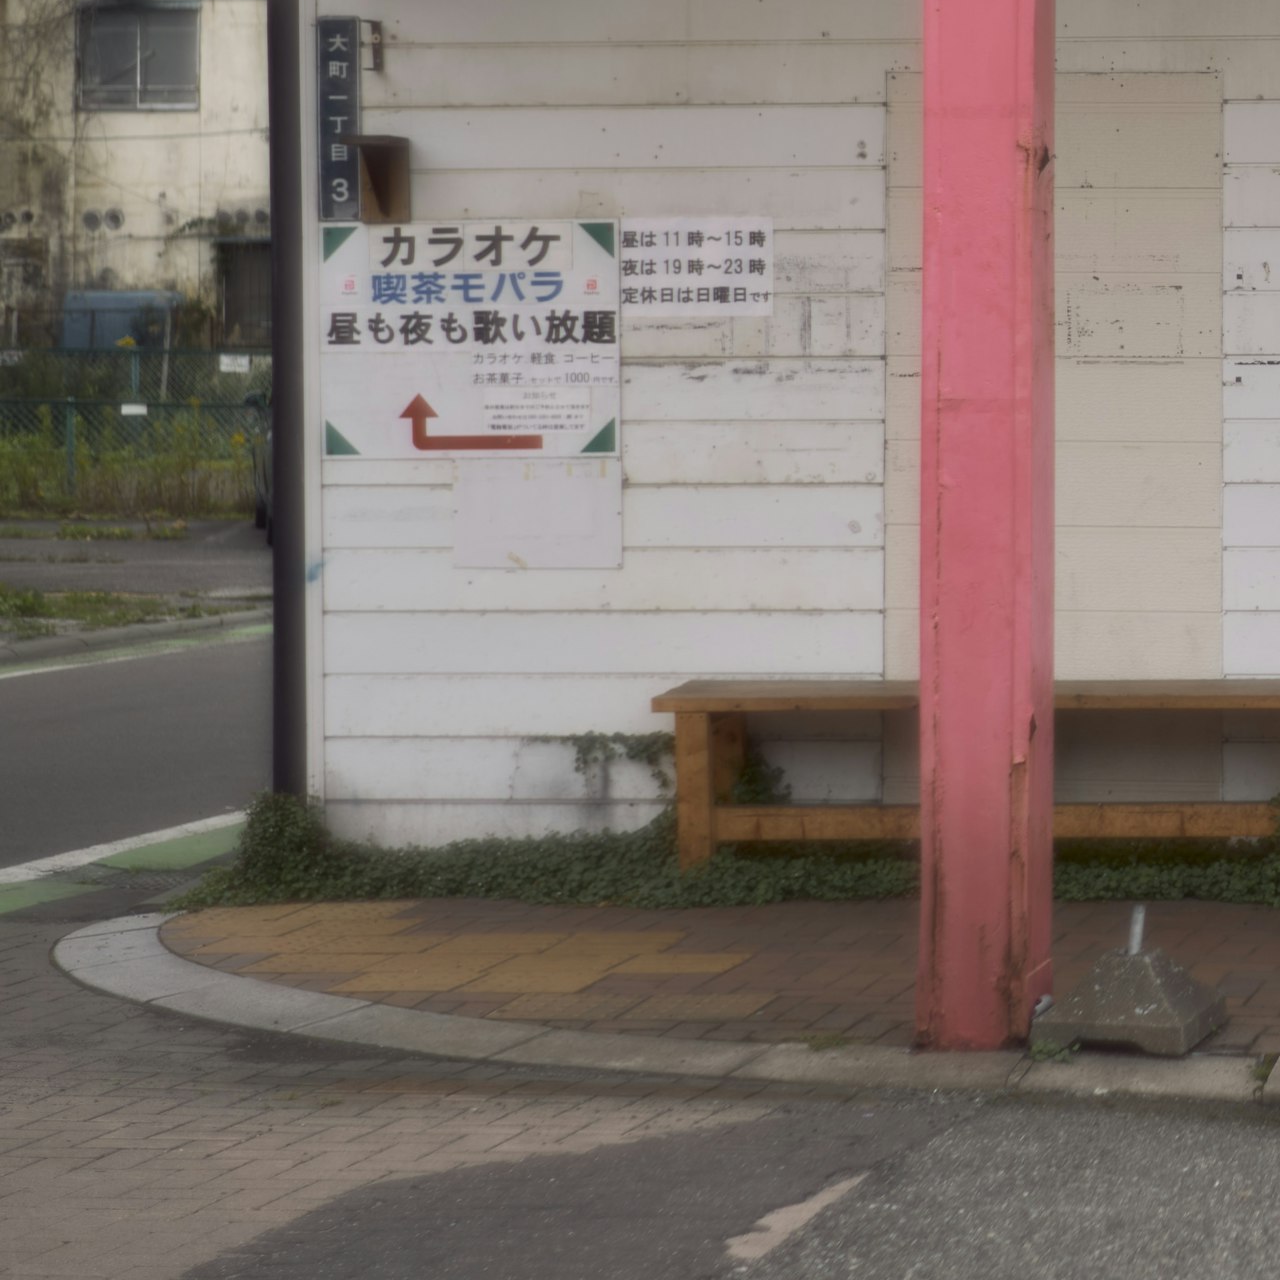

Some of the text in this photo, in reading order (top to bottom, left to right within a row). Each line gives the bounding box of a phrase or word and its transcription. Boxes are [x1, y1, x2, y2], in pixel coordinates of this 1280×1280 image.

[380, 226, 561, 267] カラオケ
[371, 272, 564, 305] 喫茶モパラ
[622, 286, 772, 304] 定休日は日曜日です
[327, 310, 616, 345] 昼も夜も歌い放題
